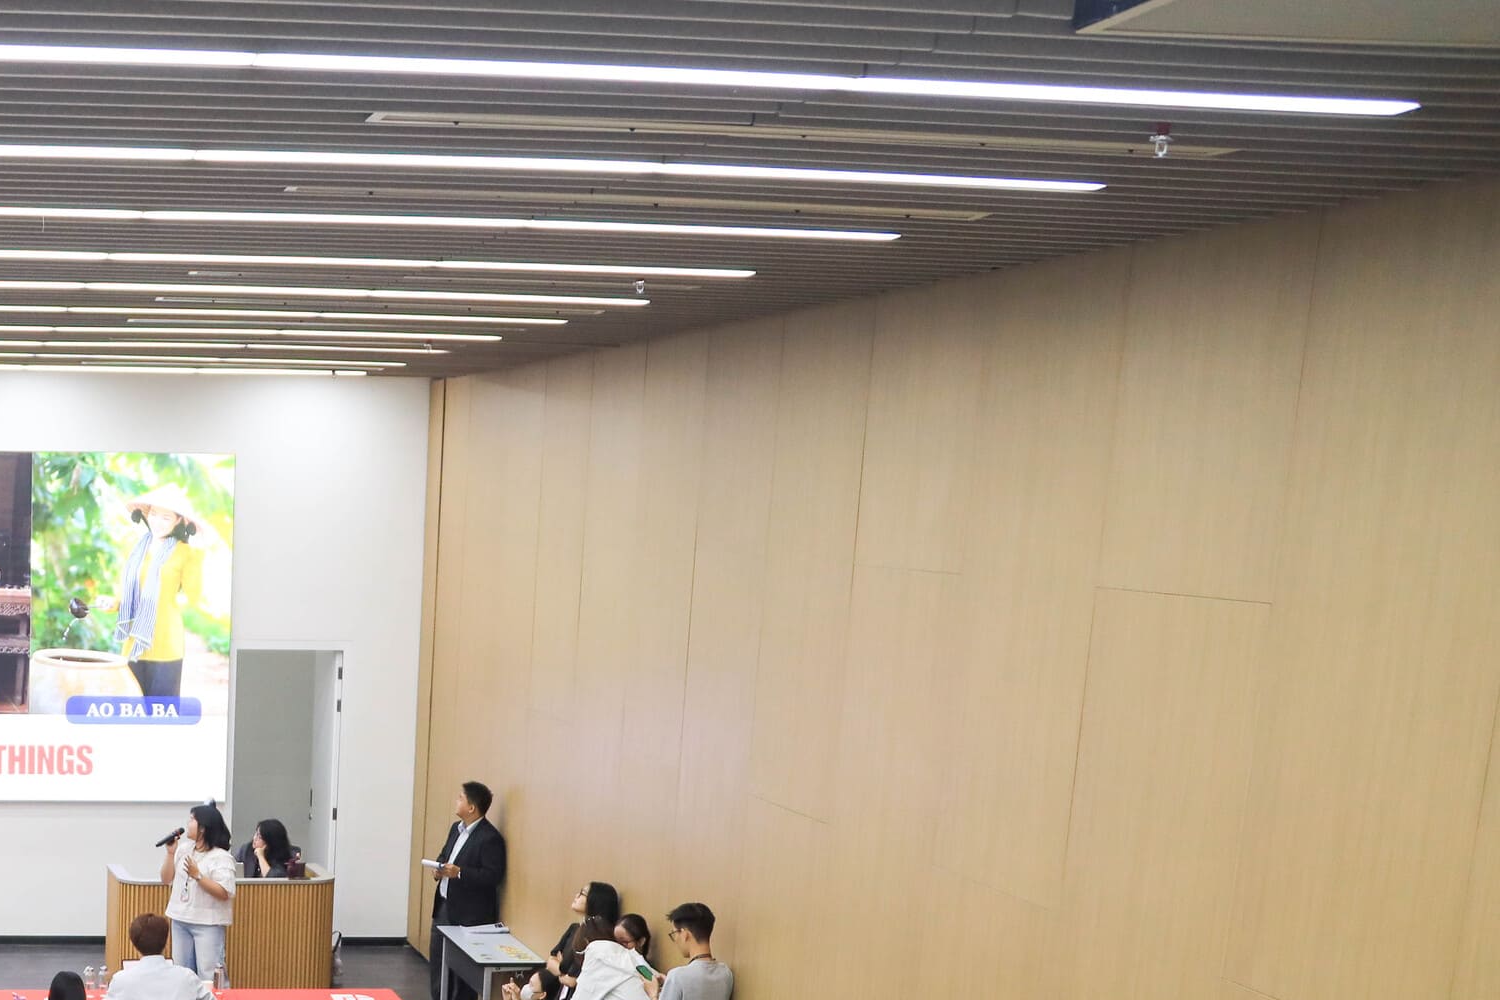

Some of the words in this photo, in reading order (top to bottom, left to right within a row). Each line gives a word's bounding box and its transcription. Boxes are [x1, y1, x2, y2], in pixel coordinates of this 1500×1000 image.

[86, 703, 115, 718] AO
[119, 703, 147, 718] BA
[151, 703, 179, 718] BA
